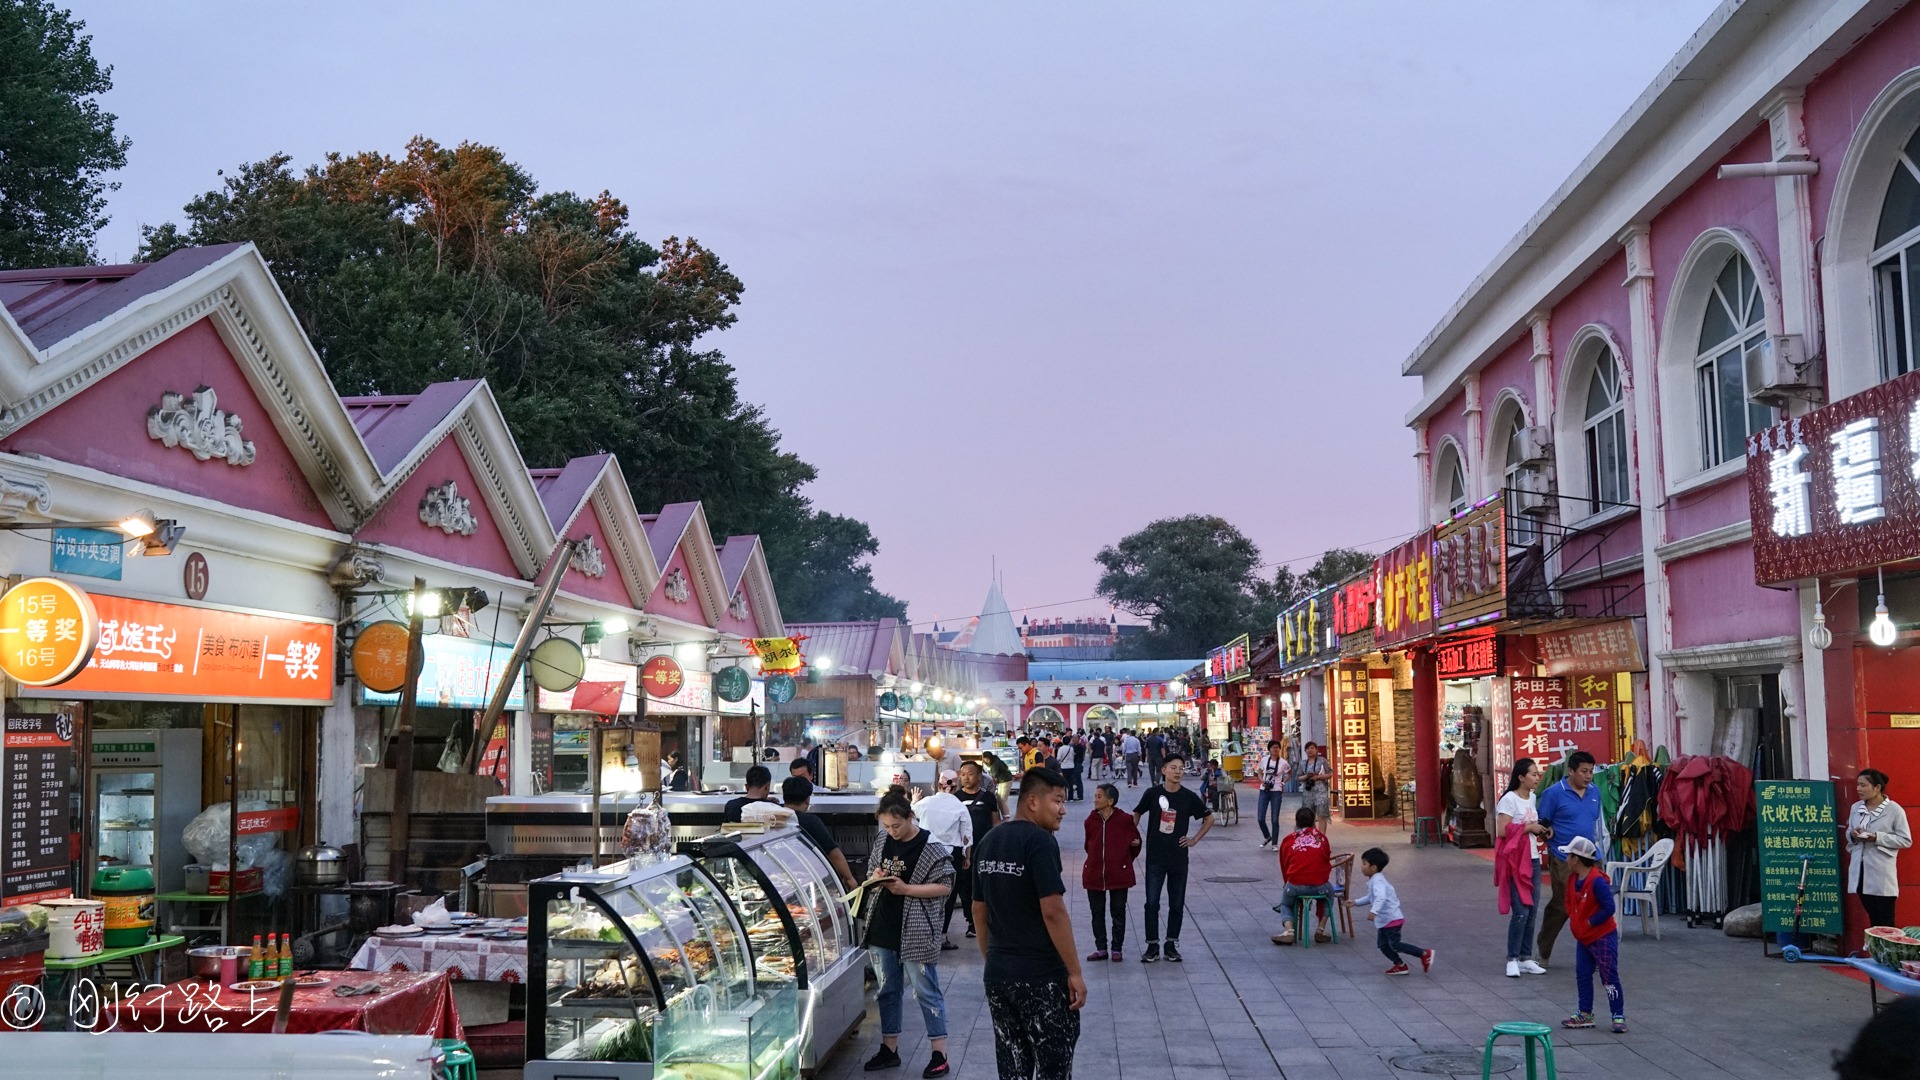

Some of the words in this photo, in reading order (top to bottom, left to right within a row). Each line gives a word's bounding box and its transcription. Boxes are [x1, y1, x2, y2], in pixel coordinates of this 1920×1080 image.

[1769, 398, 1920, 537] 新疆
[55, 534, 121, 565] 内设中央空调
[189, 560, 205, 592] 15
[17, 594, 58, 614] 15号
[0, 617, 77, 643] 一等奖
[1545, 635, 1571, 660] 金丝玉
[1570, 631, 1598, 658] 和田玉
[1598, 626, 1629, 655] 专卖店
[16, 647, 57, 667] 16号
[203, 633, 226, 657] 美食
[229, 636, 261, 660] 布尔津
[266, 639, 321, 680] 一等奖
[763, 648, 799, 663] 胡尔
[1440, 646, 1465, 672] 玉石加工
[368, 668, 395, 680] 16号
[643, 670, 681, 685] 一等奖
[1513, 679, 1563, 694] 和田玉
[1513, 696, 1563, 711] 金丝玉
[8, 718, 42, 730] 回民老字号
[1343, 697, 1367, 758] 和田玉
[1547, 712, 1602, 733] 玉石加工
[13, 773, 28, 781] 大盘鸡
[1344, 762, 1357, 806] 石榴石
[1357, 762, 1371, 806] 金丝玉
[1761, 804, 1833, 823] 代收代投点
[1764, 836, 1835, 850] 快递包裹6元/公斤
[1812, 892, 1839, 902] 2111185
[1780, 917, 1826, 928] 30分上门取件
